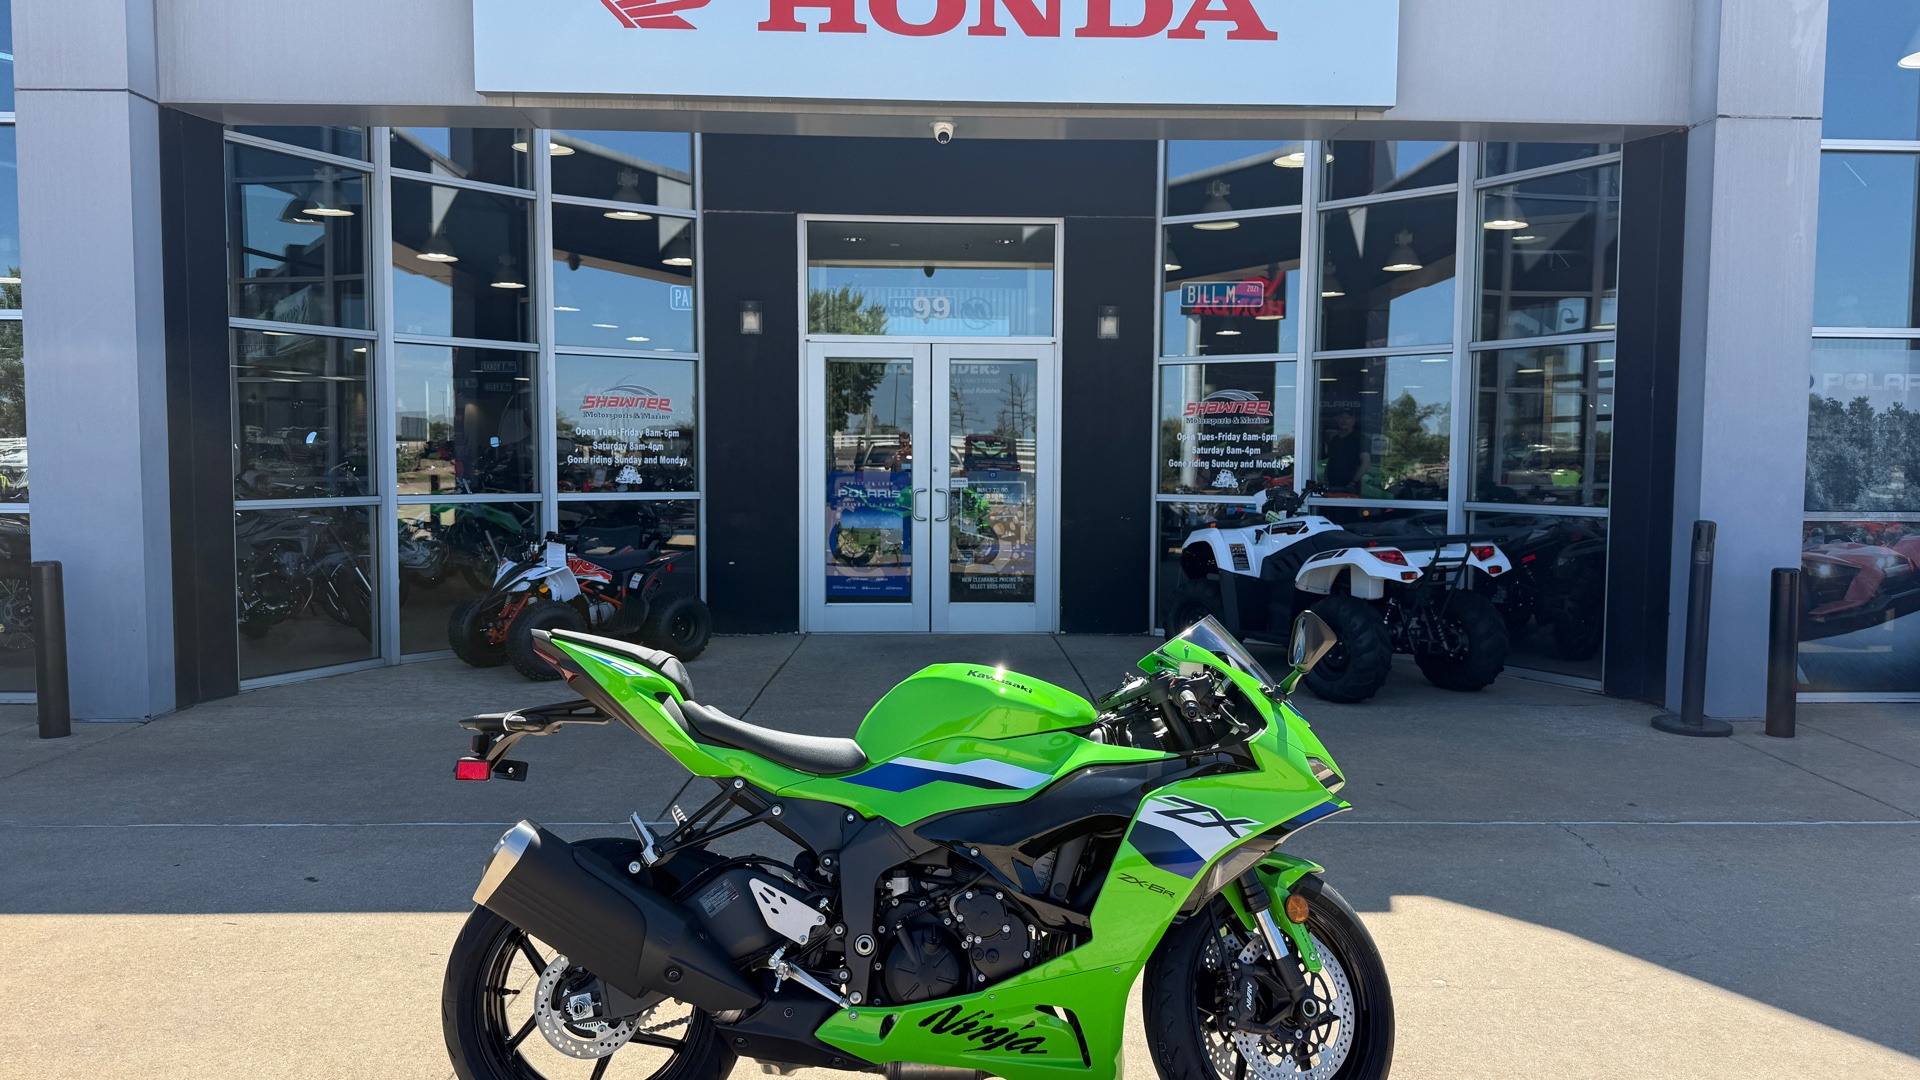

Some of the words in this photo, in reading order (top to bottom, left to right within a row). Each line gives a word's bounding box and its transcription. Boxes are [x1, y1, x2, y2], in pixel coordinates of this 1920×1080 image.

[1187, 285, 1220, 304] BILL
[1225, 285, 1241, 304] M.
[1246, 285, 1259, 293] 2021
[913, 296, 950, 319] 99
[1186, 416, 1232, 426] Motorsports
[1240, 416, 1270, 425] Marine
[575, 427, 596, 438] Open
[645, 427, 680, 439] 8am-6pm
[1176, 432, 1196, 443] Open
[1242, 432, 1278, 443] 8am-6pm
[592, 441, 627, 452] Saturday
[629, 441, 664, 452] 8am-4pm
[1191, 446, 1225, 457] Saturday
[1226, 446, 1261, 456] 8am-4pm
[567, 455, 588, 464] Gone
[590, 455, 613, 466] riding
[614, 455, 642, 466] Sunday
[643, 455, 658, 464] and
[659, 455, 688, 467] Monday
[1168, 459, 1188, 468] Gone
[1188, 459, 1210, 470] riding
[1211, 459, 1239, 470] Sunday
[1240, 459, 1254, 468] and
[1256, 459, 1285, 470] Monday
[837, 489, 902, 498] POLARIS
[1152, 796, 1256, 839] ZX
[1116, 872, 1176, 899] ZX-6R
[917, 1004, 1048, 1055] Ninja
